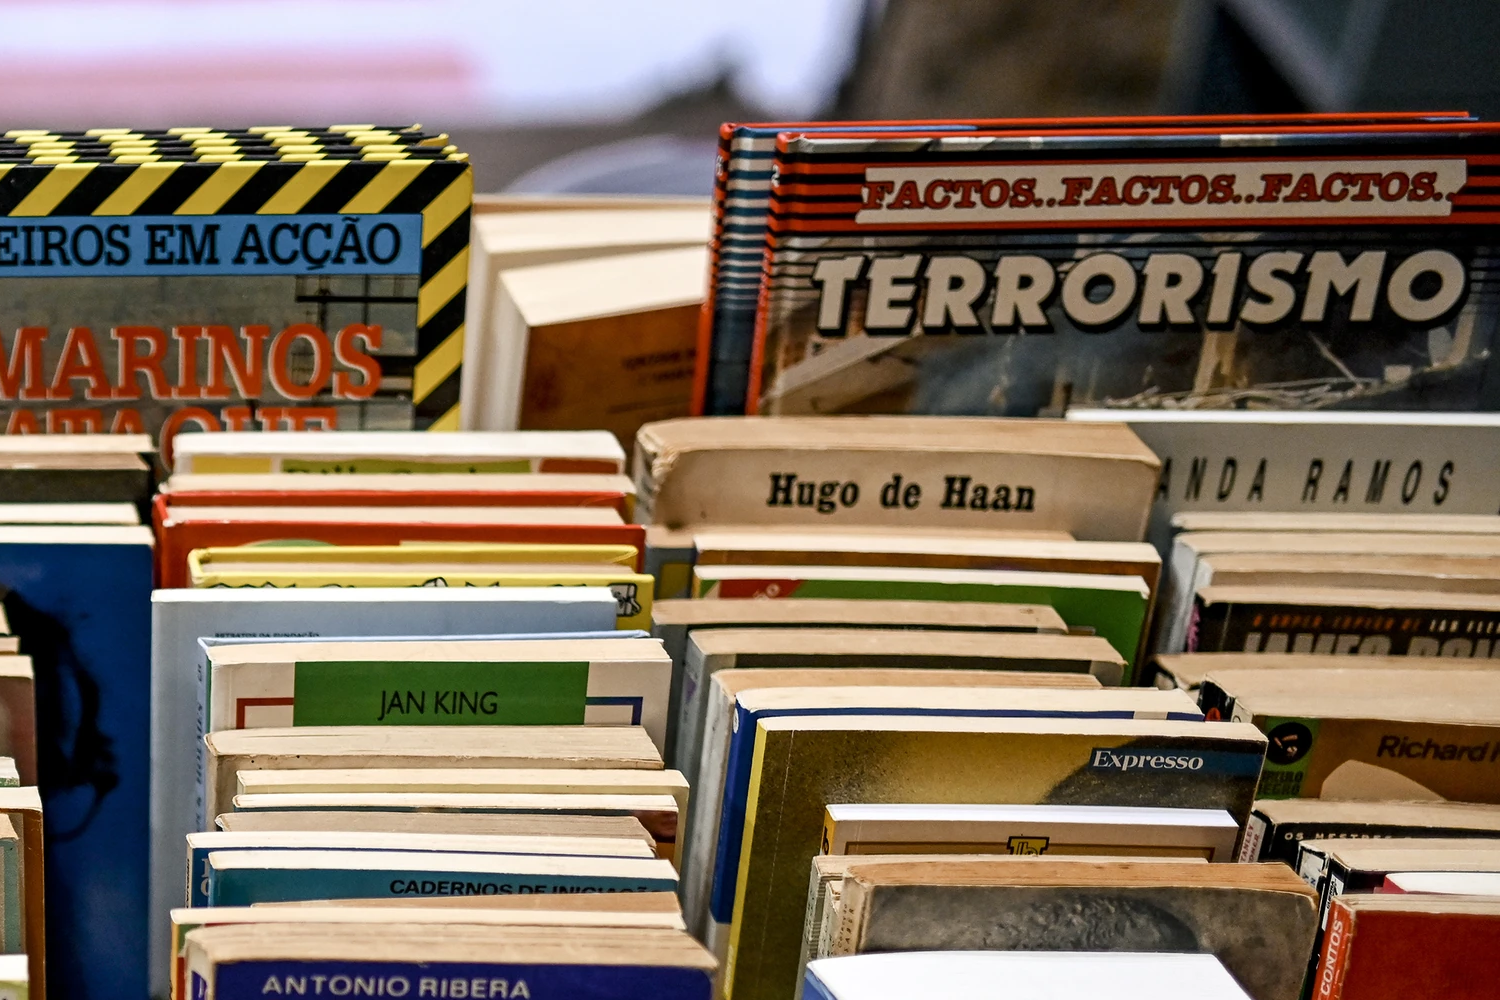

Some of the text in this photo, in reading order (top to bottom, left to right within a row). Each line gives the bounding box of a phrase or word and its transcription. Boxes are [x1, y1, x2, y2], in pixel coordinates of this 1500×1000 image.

[145, 223, 221, 268] EM
[235, 216, 402, 272] ACÇÃO
[811, 248, 1468, 337] TERRORISMO
[766, 473, 1037, 514] Hugo de Haan
[1301, 457, 1456, 506] RAMOS
[378, 690, 498, 720] JAN KING
[1091, 748, 1204, 773] Expresso
[1376, 734, 1489, 763] Richard
[1240, 822, 1255, 863] TANLEY
[1284, 831, 1305, 841] OS
[389, 879, 513, 896] CADERNOS
[1320, 919, 1343, 996] CONTOS
[262, 975, 531, 999] ANTONIO RIBERA
